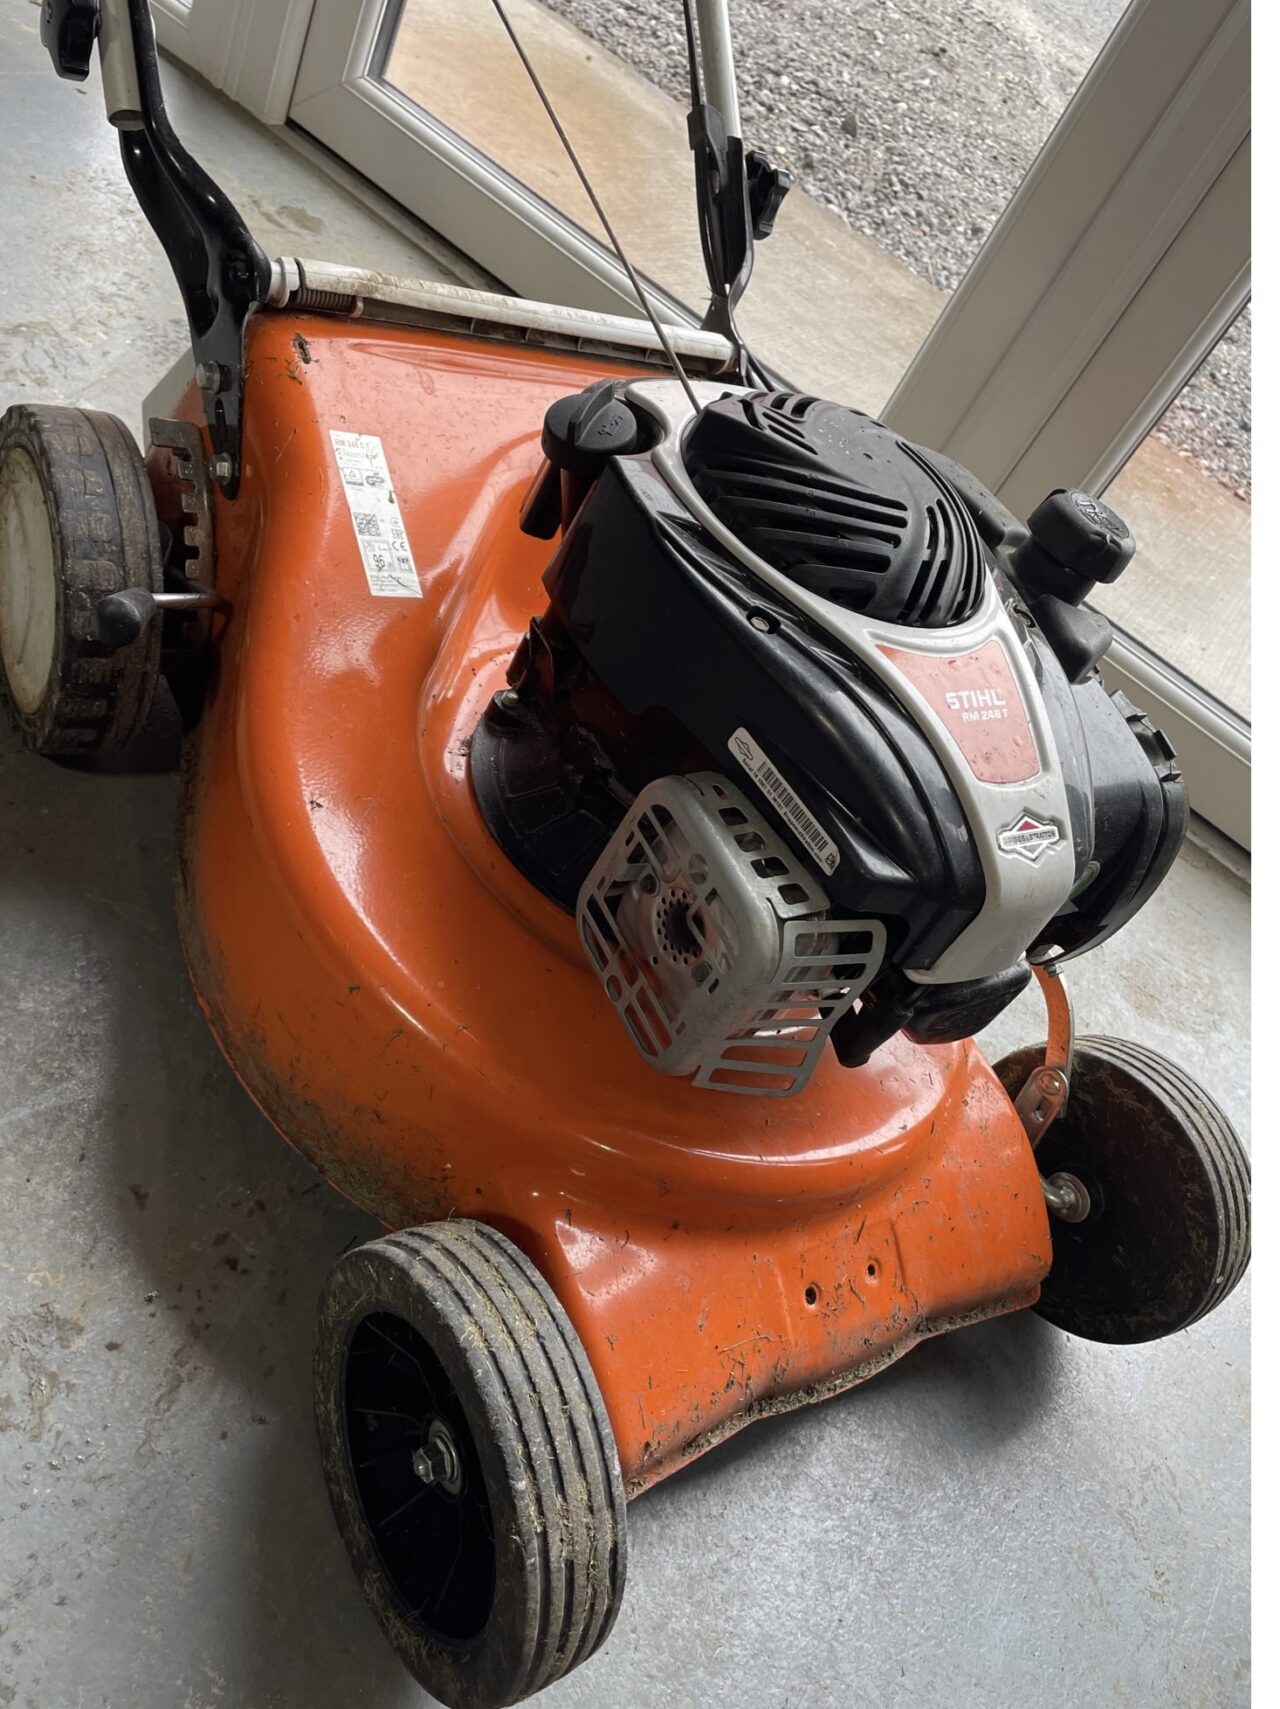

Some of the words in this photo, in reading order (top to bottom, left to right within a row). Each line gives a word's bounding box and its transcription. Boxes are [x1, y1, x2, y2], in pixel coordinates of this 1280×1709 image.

[372, 553, 386, 569] 96
[945, 688, 1006, 710] STIHL
[962, 711, 980, 721] RM
[981, 709, 1001, 720] 248
[1001, 708, 1009, 718] T
